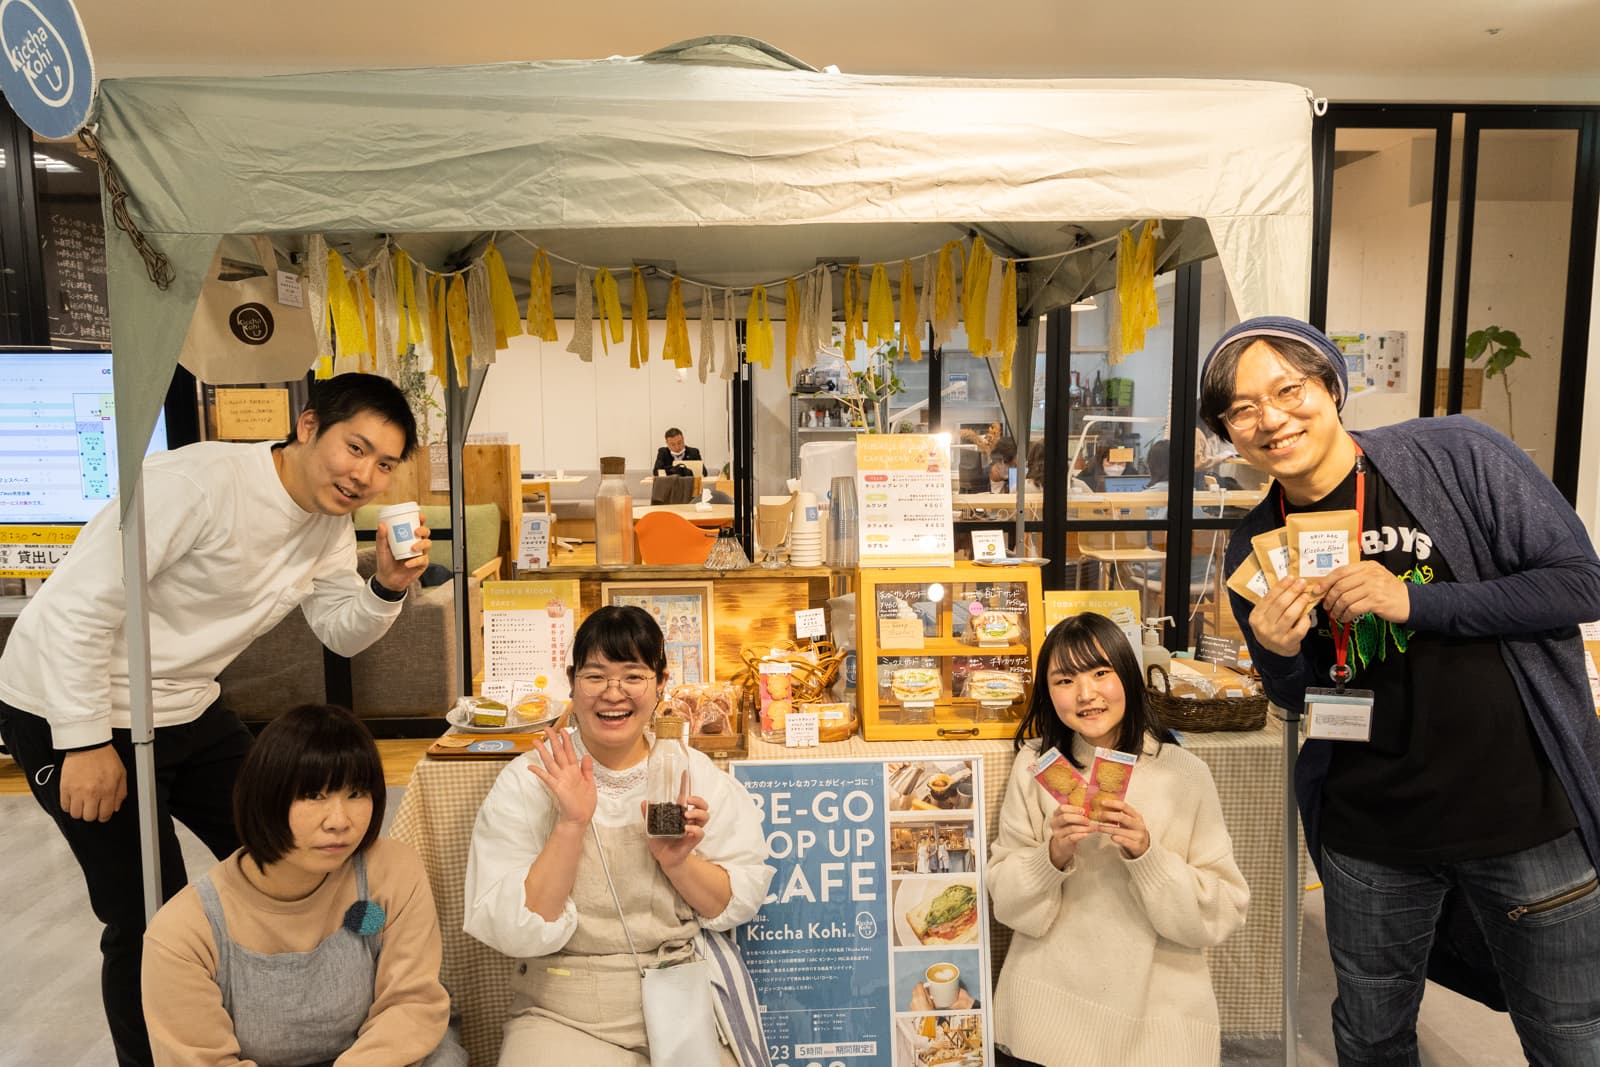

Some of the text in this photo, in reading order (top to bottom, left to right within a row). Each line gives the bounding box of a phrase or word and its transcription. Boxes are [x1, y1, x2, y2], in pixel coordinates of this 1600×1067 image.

[11, 27, 48, 72] Kiccha
[22, 43, 53, 80] Kohi
[17, 550, 69, 564] 貸出し
[766, 828, 875, 859] OP UP
[762, 861, 877, 904] AFE
[747, 923, 803, 941] Kiccha
